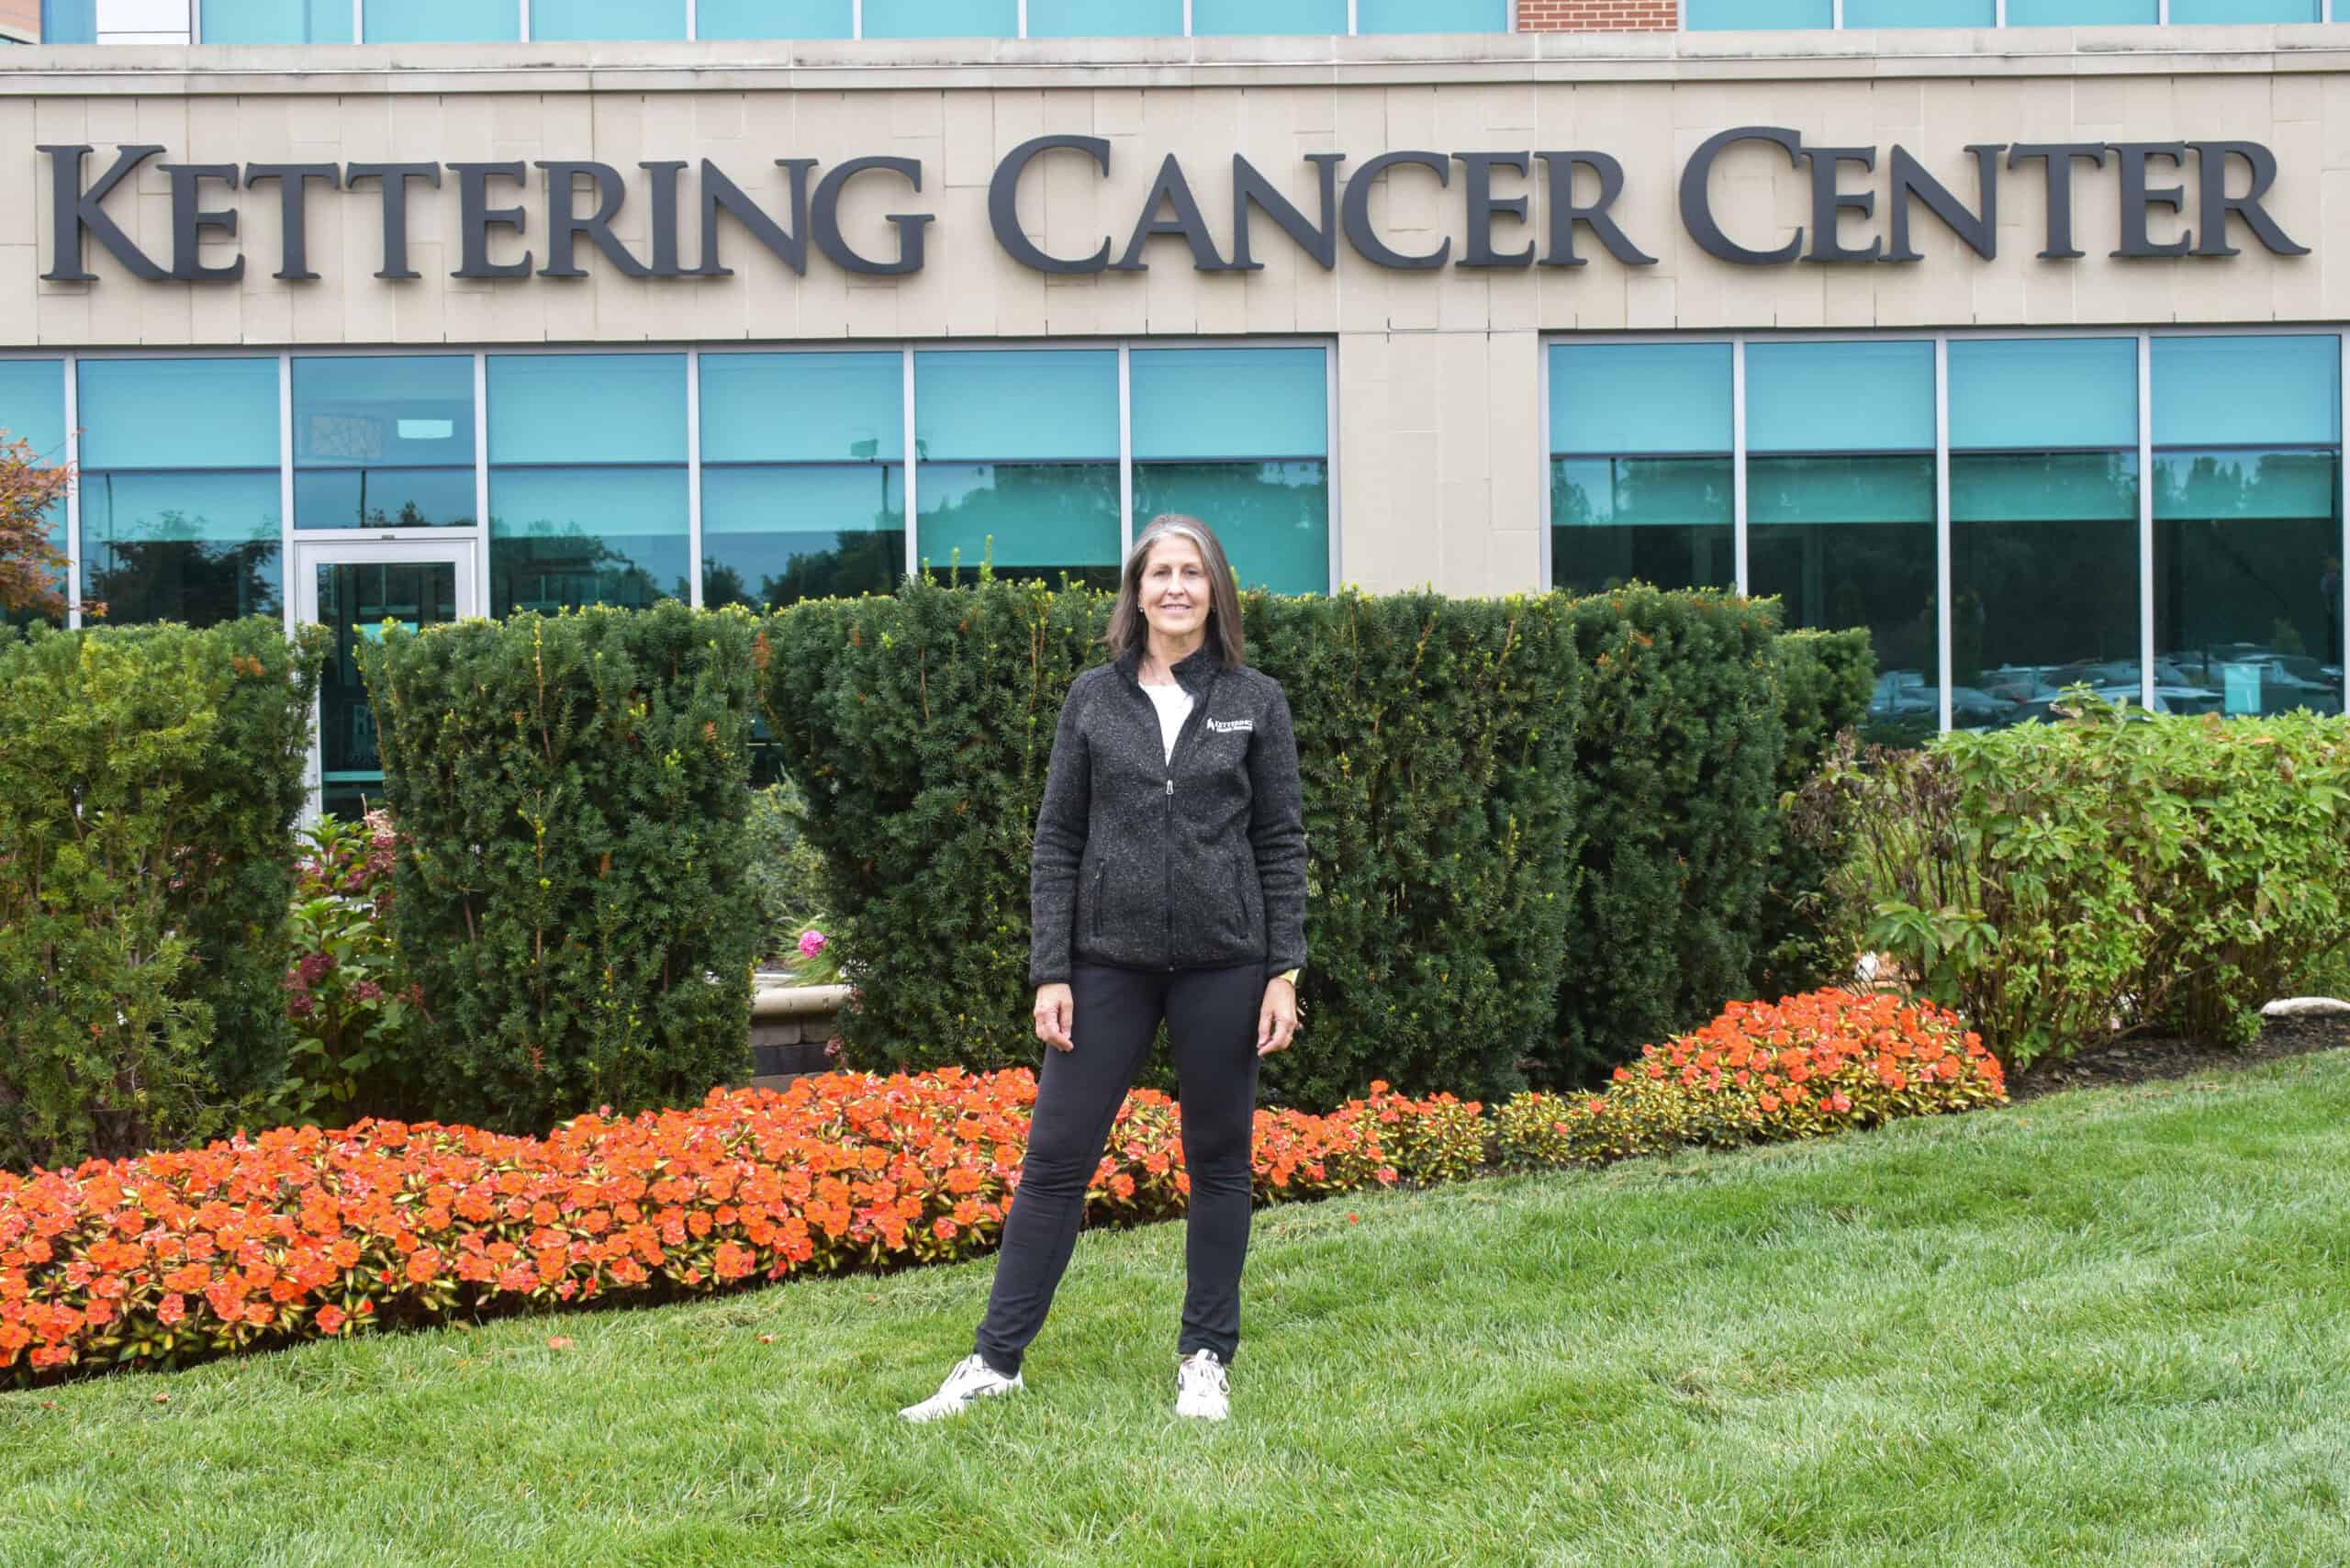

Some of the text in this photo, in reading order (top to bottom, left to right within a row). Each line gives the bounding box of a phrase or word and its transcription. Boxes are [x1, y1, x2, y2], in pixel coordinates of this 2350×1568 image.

[36, 127, 2311, 289] KETTERING CANCER CENTER
